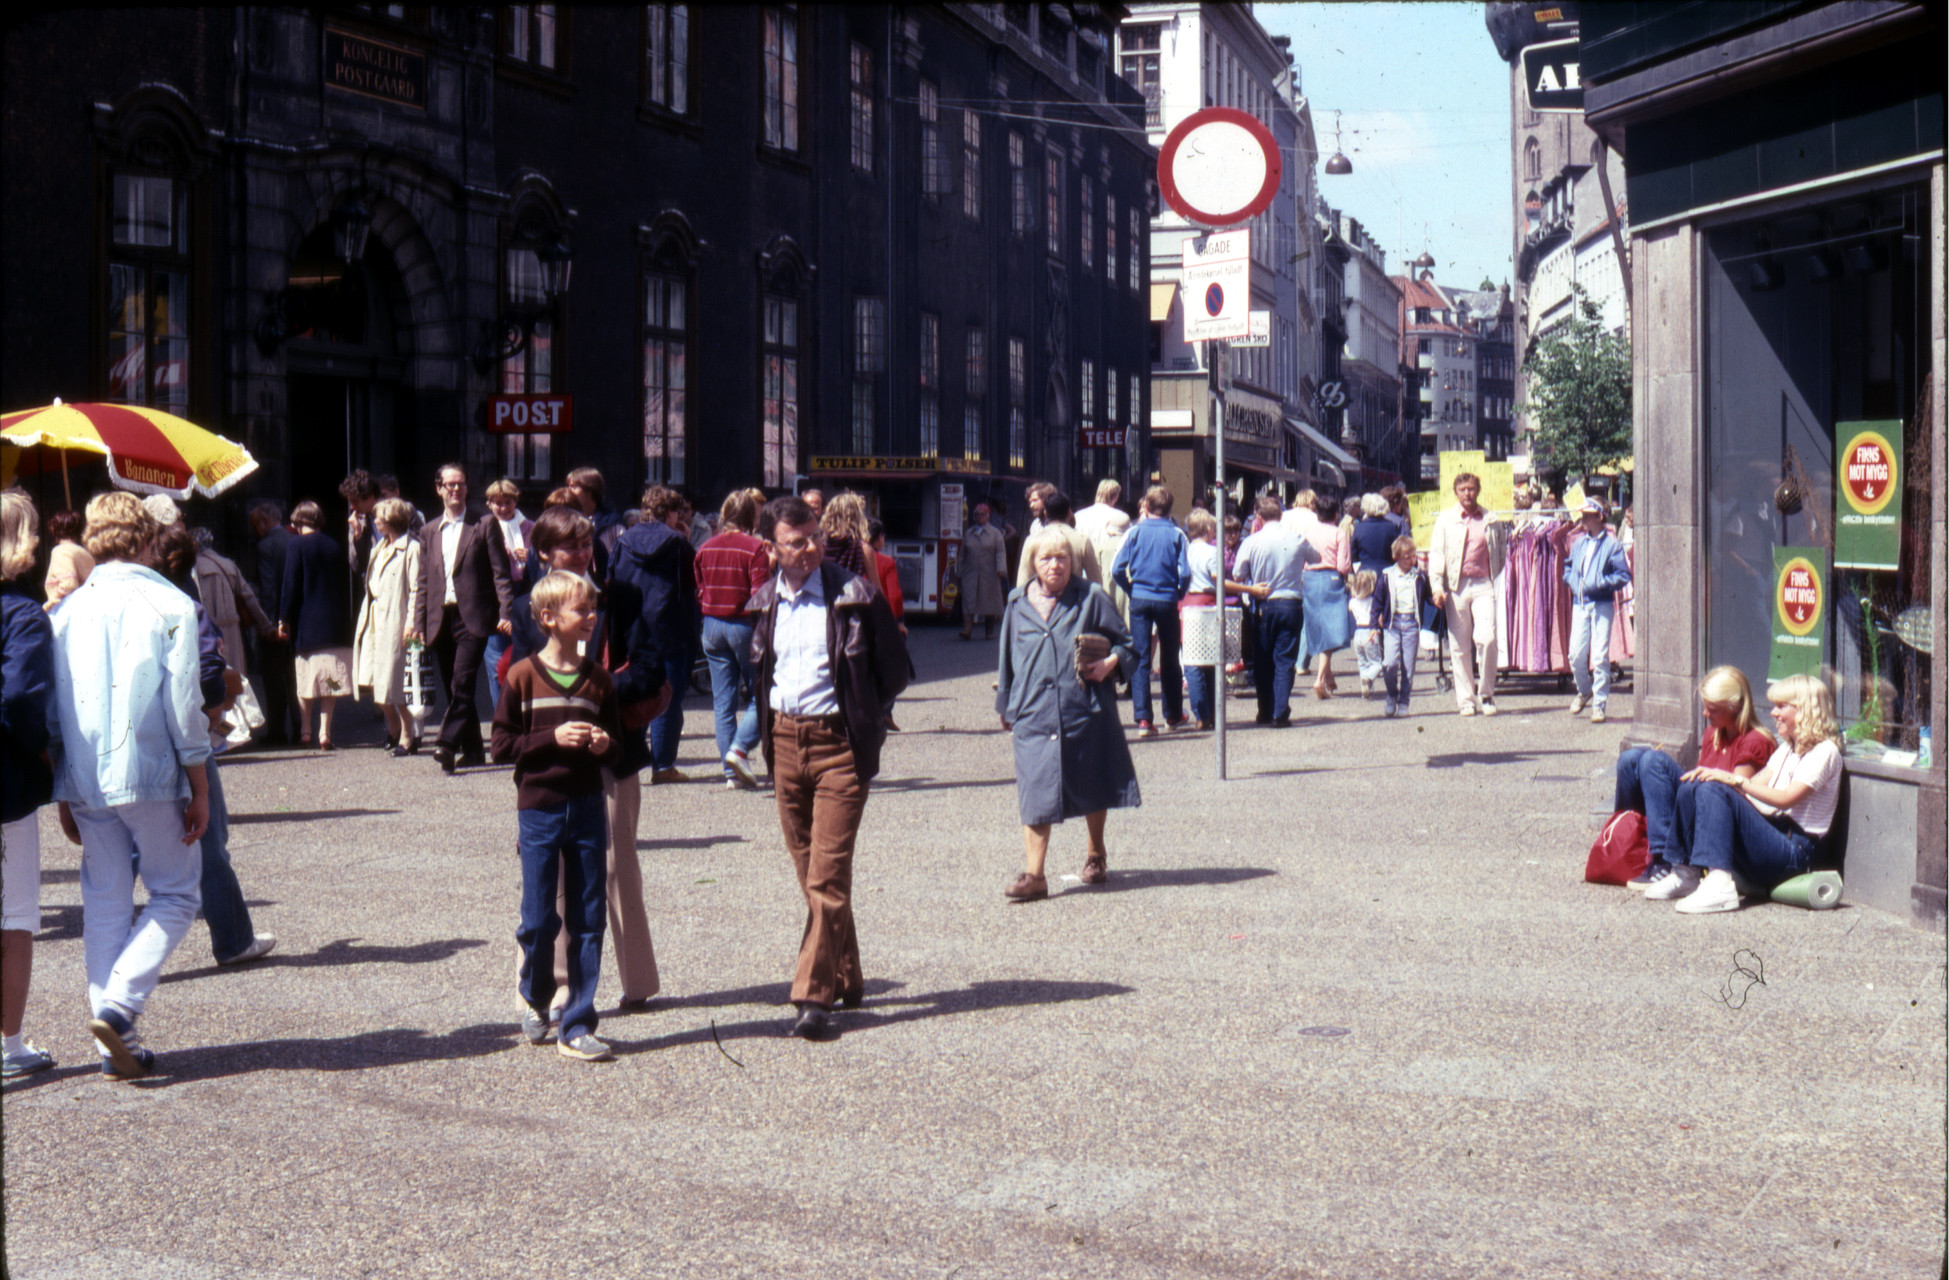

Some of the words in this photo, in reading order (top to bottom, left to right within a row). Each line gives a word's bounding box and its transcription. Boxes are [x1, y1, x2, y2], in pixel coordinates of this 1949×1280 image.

[495, 401, 564, 426] POST
[1085, 431, 1123, 445] TELE
[1856, 446, 1880, 463] FINNS
[816, 458, 871, 469] TULIP
[125, 458, 176, 488] Bananen
[1849, 464, 1865, 480] MOT
[1866, 464, 1888, 480] MYGG
[1791, 571, 1809, 587] FINNS
[1784, 587, 1797, 603] MOT
[1798, 587, 1815, 605] MYGG
